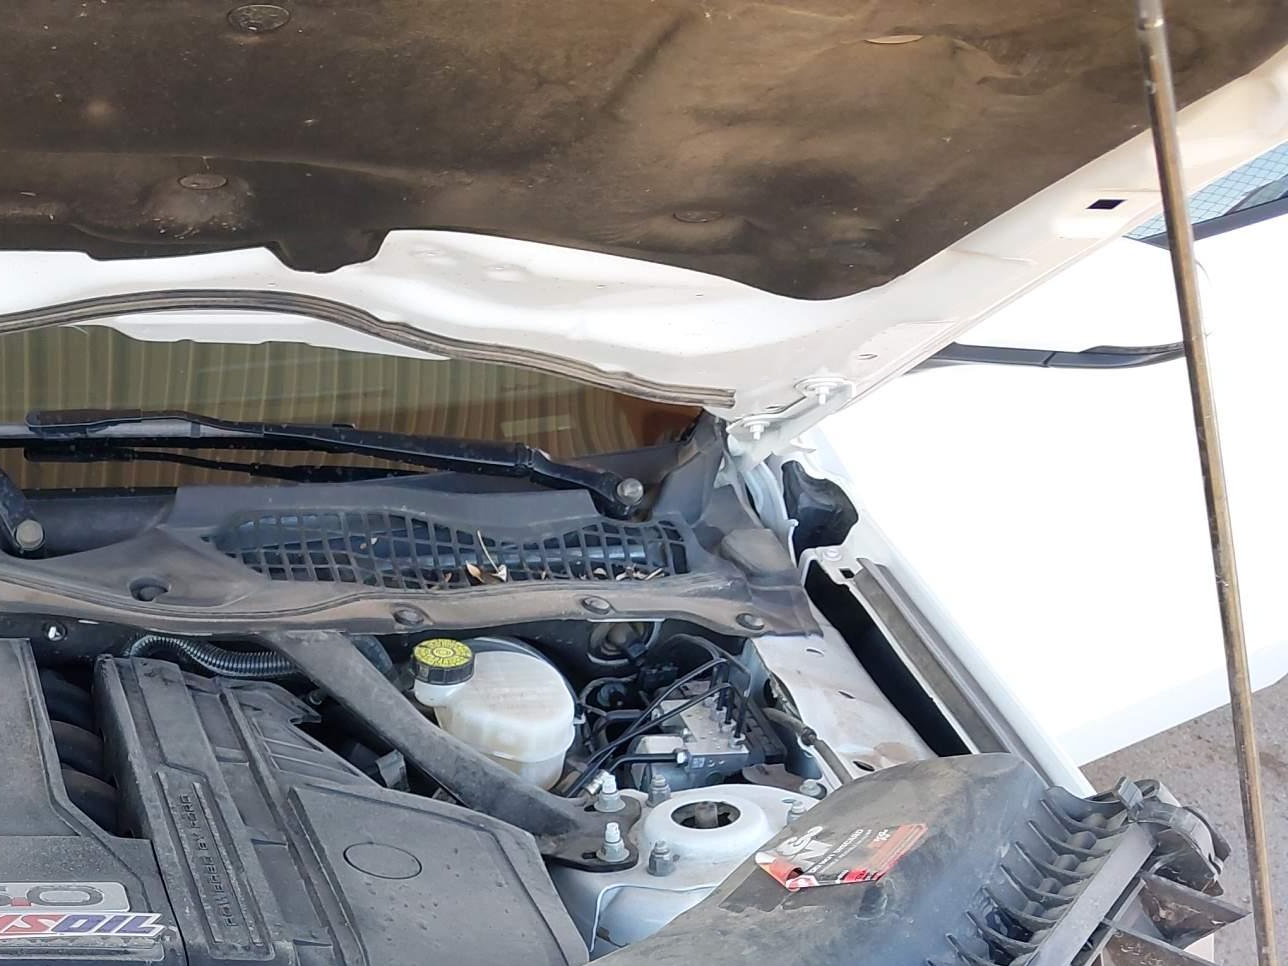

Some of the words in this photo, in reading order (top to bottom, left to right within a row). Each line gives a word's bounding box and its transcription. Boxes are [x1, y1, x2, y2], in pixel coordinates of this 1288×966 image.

[180, 795, 200, 829] FORD
[192, 833, 209, 851] BY
[202, 856, 240, 927] POWERED
